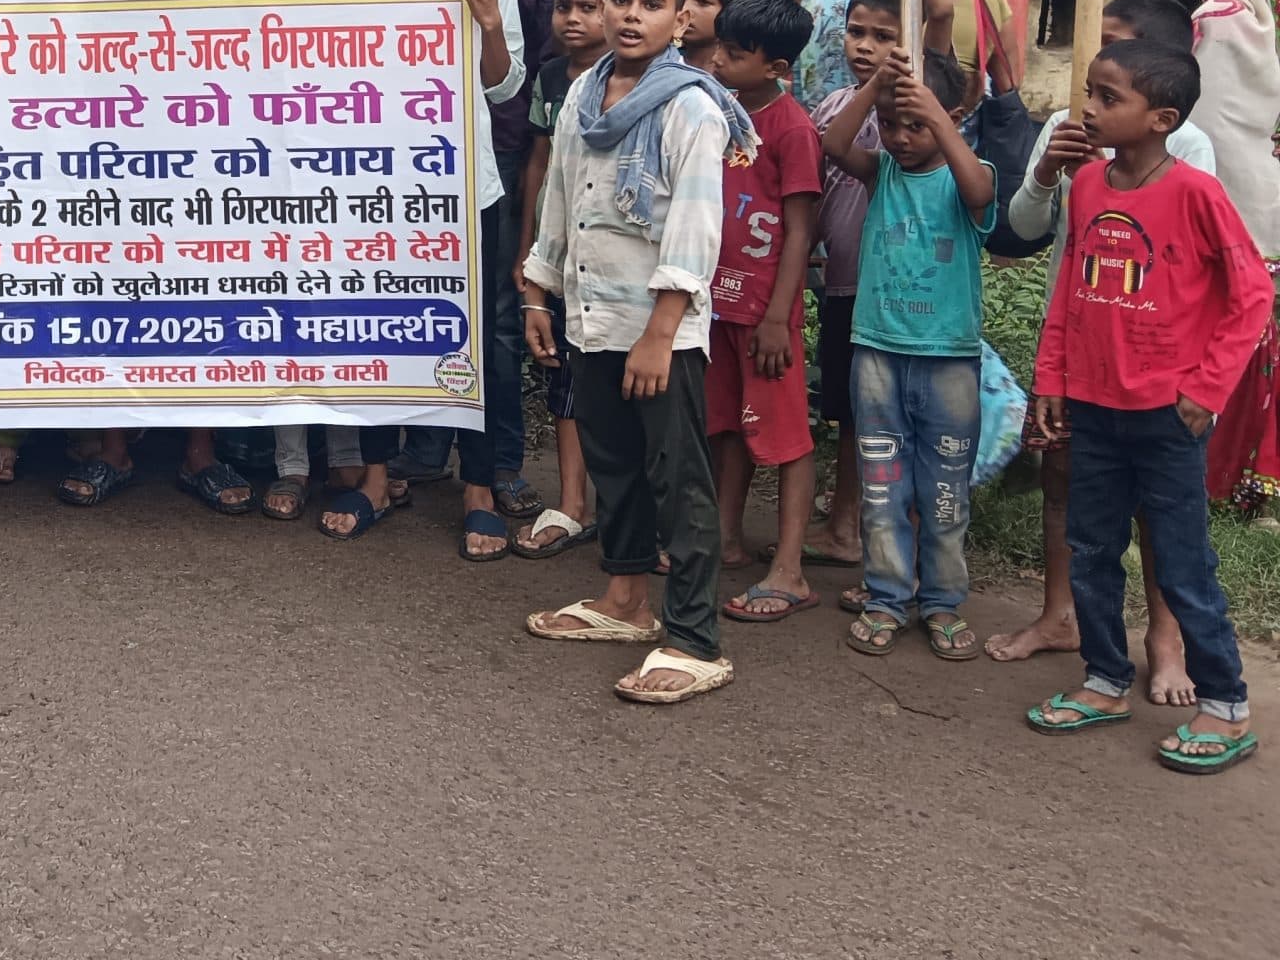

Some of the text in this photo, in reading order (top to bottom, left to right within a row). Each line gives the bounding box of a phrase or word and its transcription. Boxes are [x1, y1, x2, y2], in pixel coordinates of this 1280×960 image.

[27, 17, 67, 75] को
[260, 13, 386, 69] गिरफ्तार
[395, 8, 455, 66] करो
[9, 84, 148, 131] हत्यारे
[163, 82, 232, 127] को
[248, 81, 384, 125] फाँसी
[400, 78, 456, 125] दो
[56, 141, 198, 180] परिवार
[211, 137, 271, 178] को
[286, 146, 395, 176] न्याय
[408, 135, 457, 176] दो
[31, 198, 47, 227] 2
[56, 188, 121, 227] महीने
[129, 198, 174, 228] बाद
[183, 188, 213, 225] भी
[221, 186, 338, 225] गिरफ्तारी
[346, 185, 394, 223] नही
[402, 184, 459, 224] होना
[12, 234, 113, 265] परिवार
[122, 233, 165, 264] को
[175, 240, 251, 263] न्याय
[261, 231, 292, 263] में
[299, 231, 333, 262] हो
[344, 231, 397, 262] रही
[408, 230, 461, 262] देरी
[1111, 230, 1131, 239] NEED
[1100, 257, 1124, 269] MUSIC
[72, 272, 103, 296] को
[112, 271, 209, 301] खुलेआम
[218, 270, 288, 295] धमकी
[296, 270, 332, 296] देने
[340, 269, 365, 294] के
[373, 270, 466, 294] खिलाफ
[720, 277, 741, 291] 1983
[908, 300, 935, 314] ROLL
[47, 317, 224, 345] 15.07.2025
[236, 306, 283, 343] को
[294, 307, 462, 344] महाप्रदर्शन
[123, 365, 196, 383] समस्त
[204, 359, 267, 382] कोशी
[274, 359, 325, 382] चौक
[333, 359, 389, 382] वासी
[935, 482, 954, 523] CASUAL
